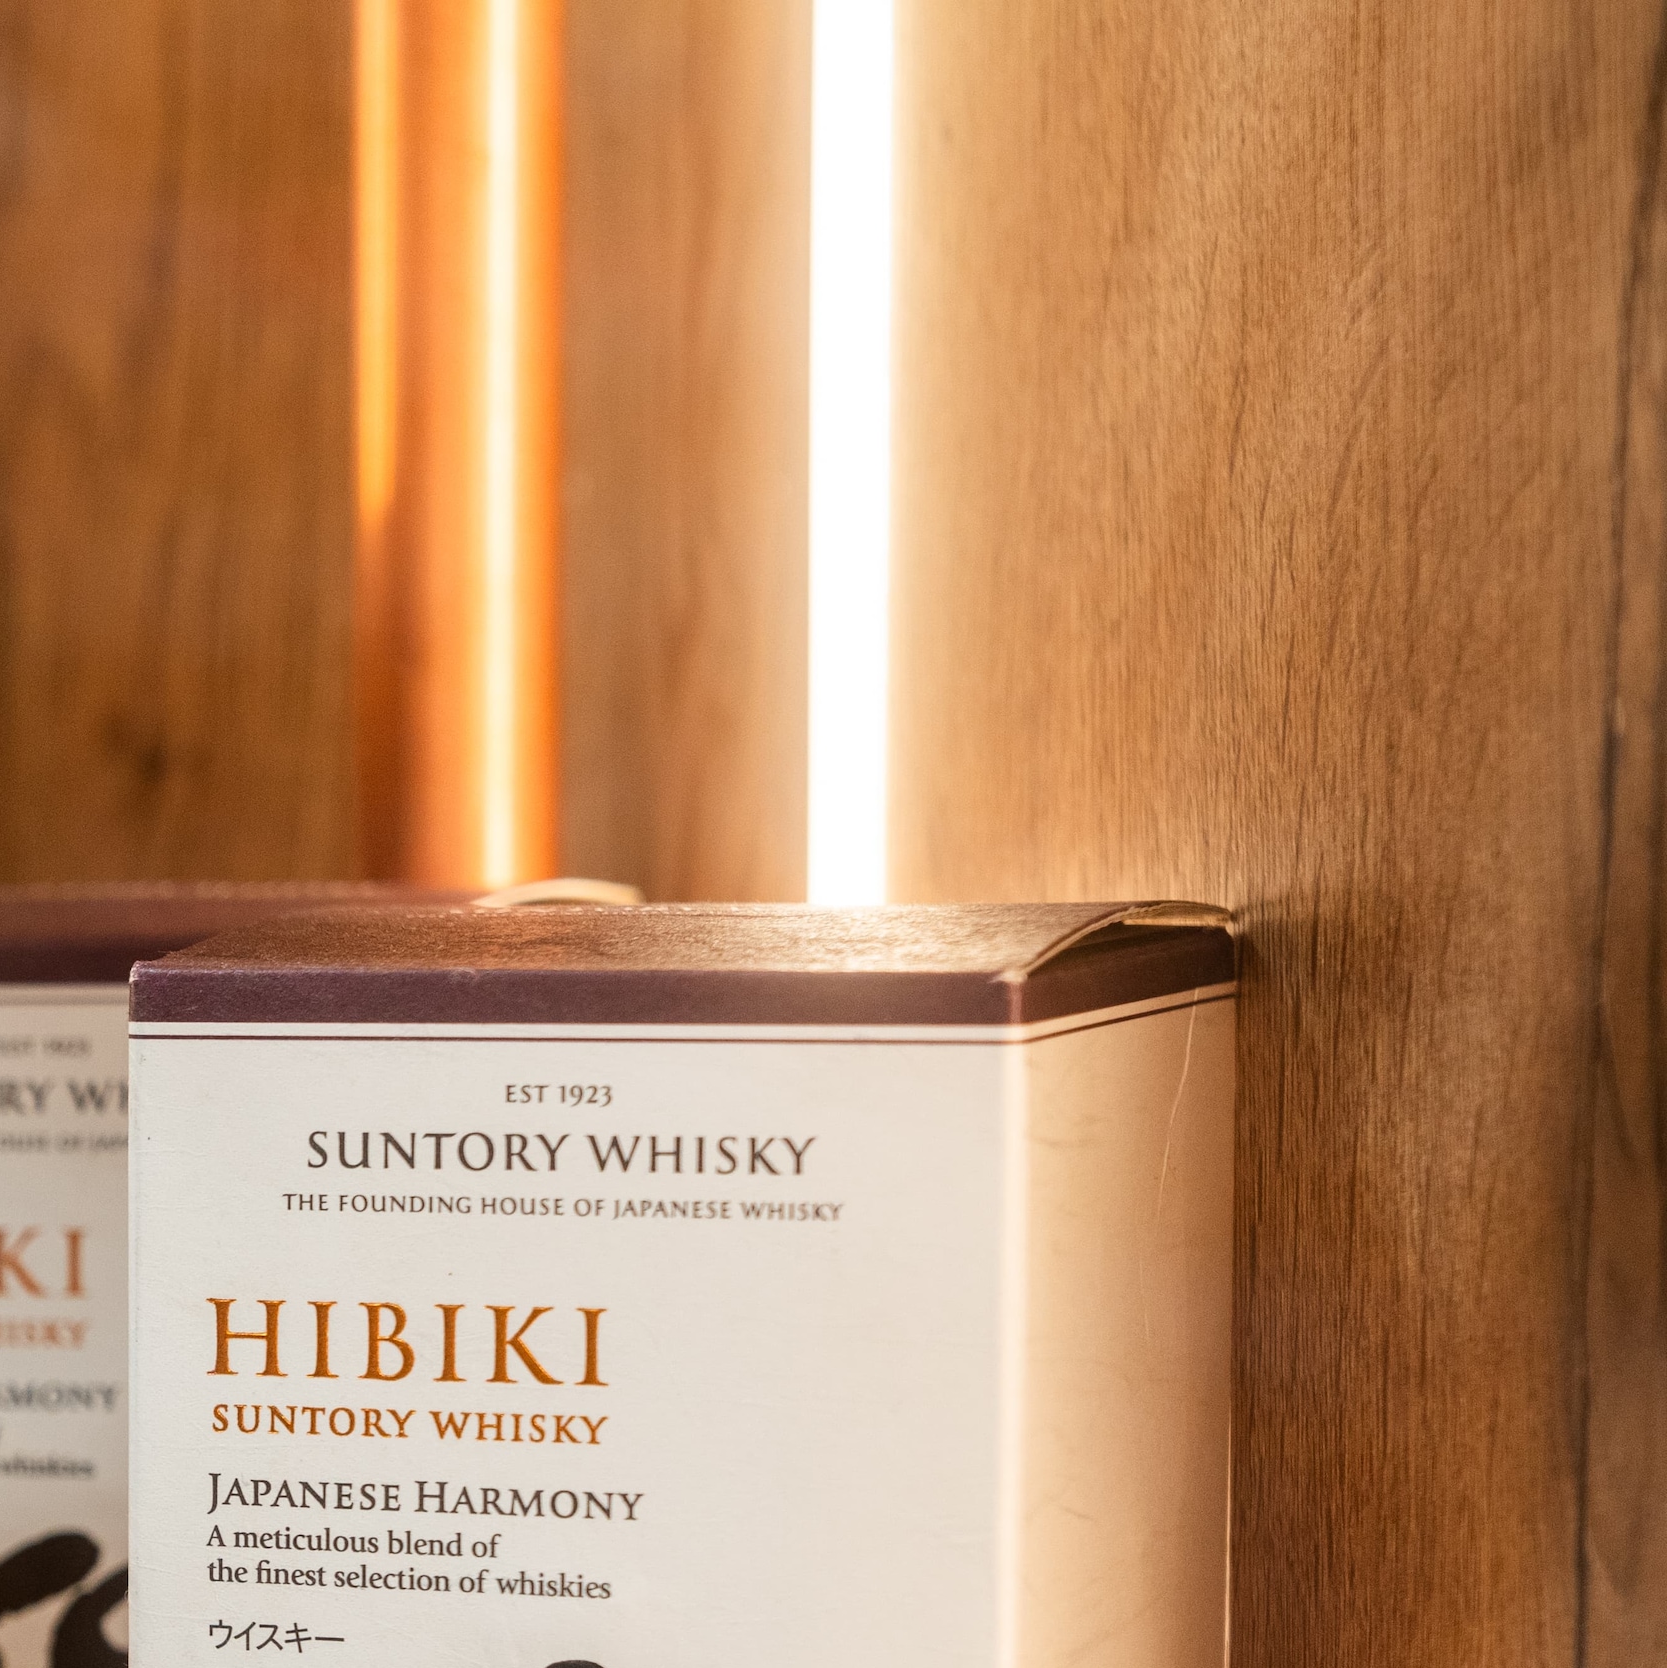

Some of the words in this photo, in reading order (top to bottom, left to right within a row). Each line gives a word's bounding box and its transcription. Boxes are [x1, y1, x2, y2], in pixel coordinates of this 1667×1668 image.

[505, 1084, 550, 1106] EST
[557, 1084, 613, 1109] 1923
[306, 1130, 571, 1174] SUNTORY
[586, 1133, 817, 1178] WHISKY
[282, 1192, 333, 1213] THE
[339, 1193, 473, 1217] FOUNDING
[480, 1196, 566, 1217] HOUSE
[574, 1197, 606, 1218] OF
[612, 1198, 733, 1222] JAPANESE
[738, 1200, 846, 1223] WHISKY
[206, 1297, 610, 1388] HIBIKI
[212, 1404, 415, 1441] SUNTORY
[430, 1410, 608, 1447] WHISKY
[206, 1526, 228, 1548] A
[233, 1525, 379, 1556] meticulous
[387, 1529, 461, 1560] blend
[468, 1532, 501, 1560] of
[208, 1558, 248, 1585] the
[255, 1560, 327, 1588] finest
[333, 1562, 452, 1594] selection
[458, 1566, 490, 1594] of
[495, 1569, 613, 1601] whiskies
[207, 1620, 346, 1655] ウイスキー
